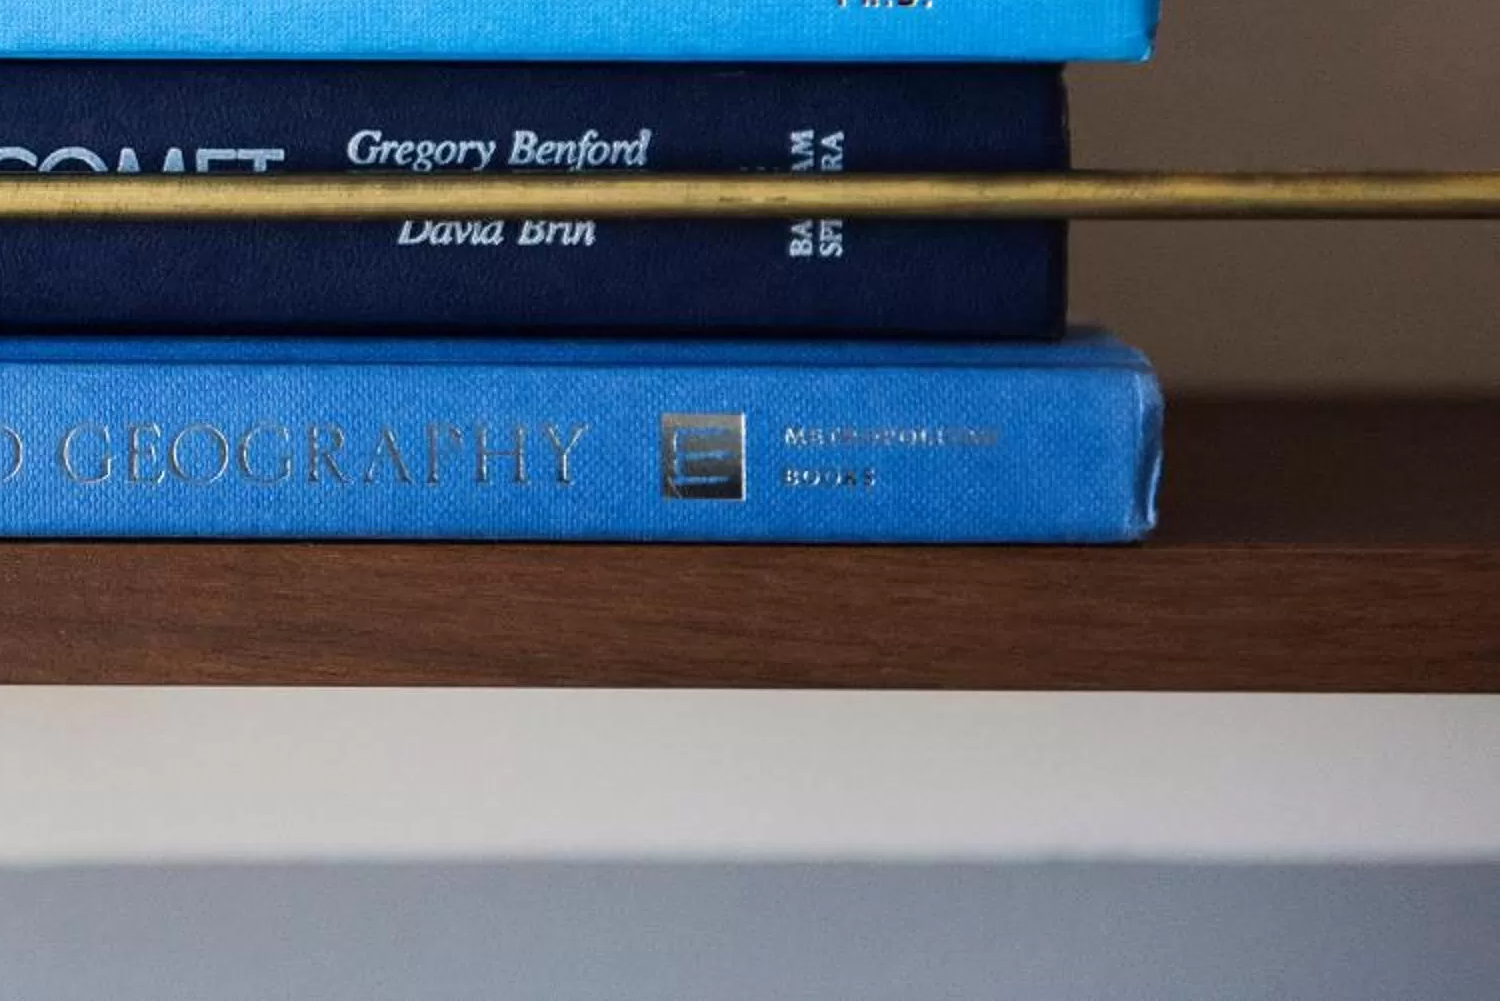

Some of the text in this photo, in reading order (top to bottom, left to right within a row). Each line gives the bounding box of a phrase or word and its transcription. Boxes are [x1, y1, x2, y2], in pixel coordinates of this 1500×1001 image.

[348, 129, 652, 170] Gregory Benford
[789, 129, 814, 256] BAAM
[60, 423, 588, 486] GEOGRAPHY
